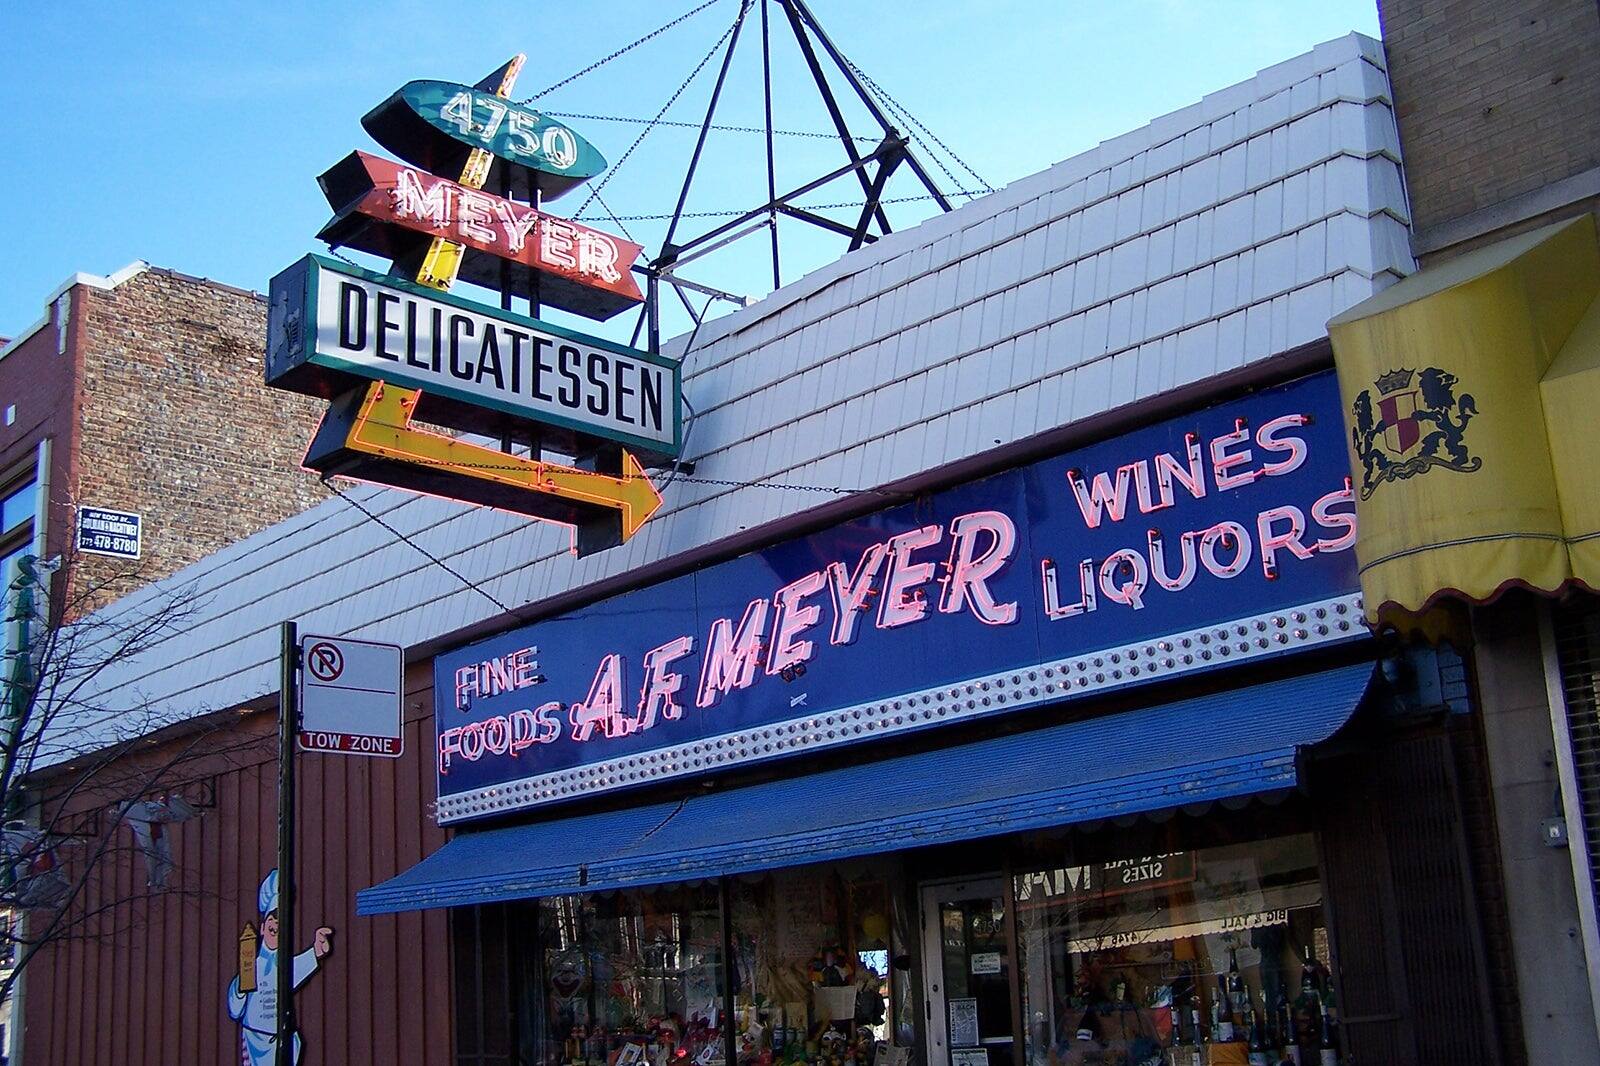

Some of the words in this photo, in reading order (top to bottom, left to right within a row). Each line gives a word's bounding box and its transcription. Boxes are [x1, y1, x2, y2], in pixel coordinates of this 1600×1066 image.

[440, 91, 577, 169] 4750
[394, 168, 622, 284] MEYER
[338, 281, 662, 431] DELICATESSEN
[1068, 413, 1308, 528] WINES
[1042, 478, 1356, 621] LIQUORS
[697, 511, 1017, 707] MEYER
[455, 645, 542, 710] FINE
[307, 732, 341, 749] TOW
[350, 736, 393, 752] ZONE
[439, 701, 562, 773] FOODS
